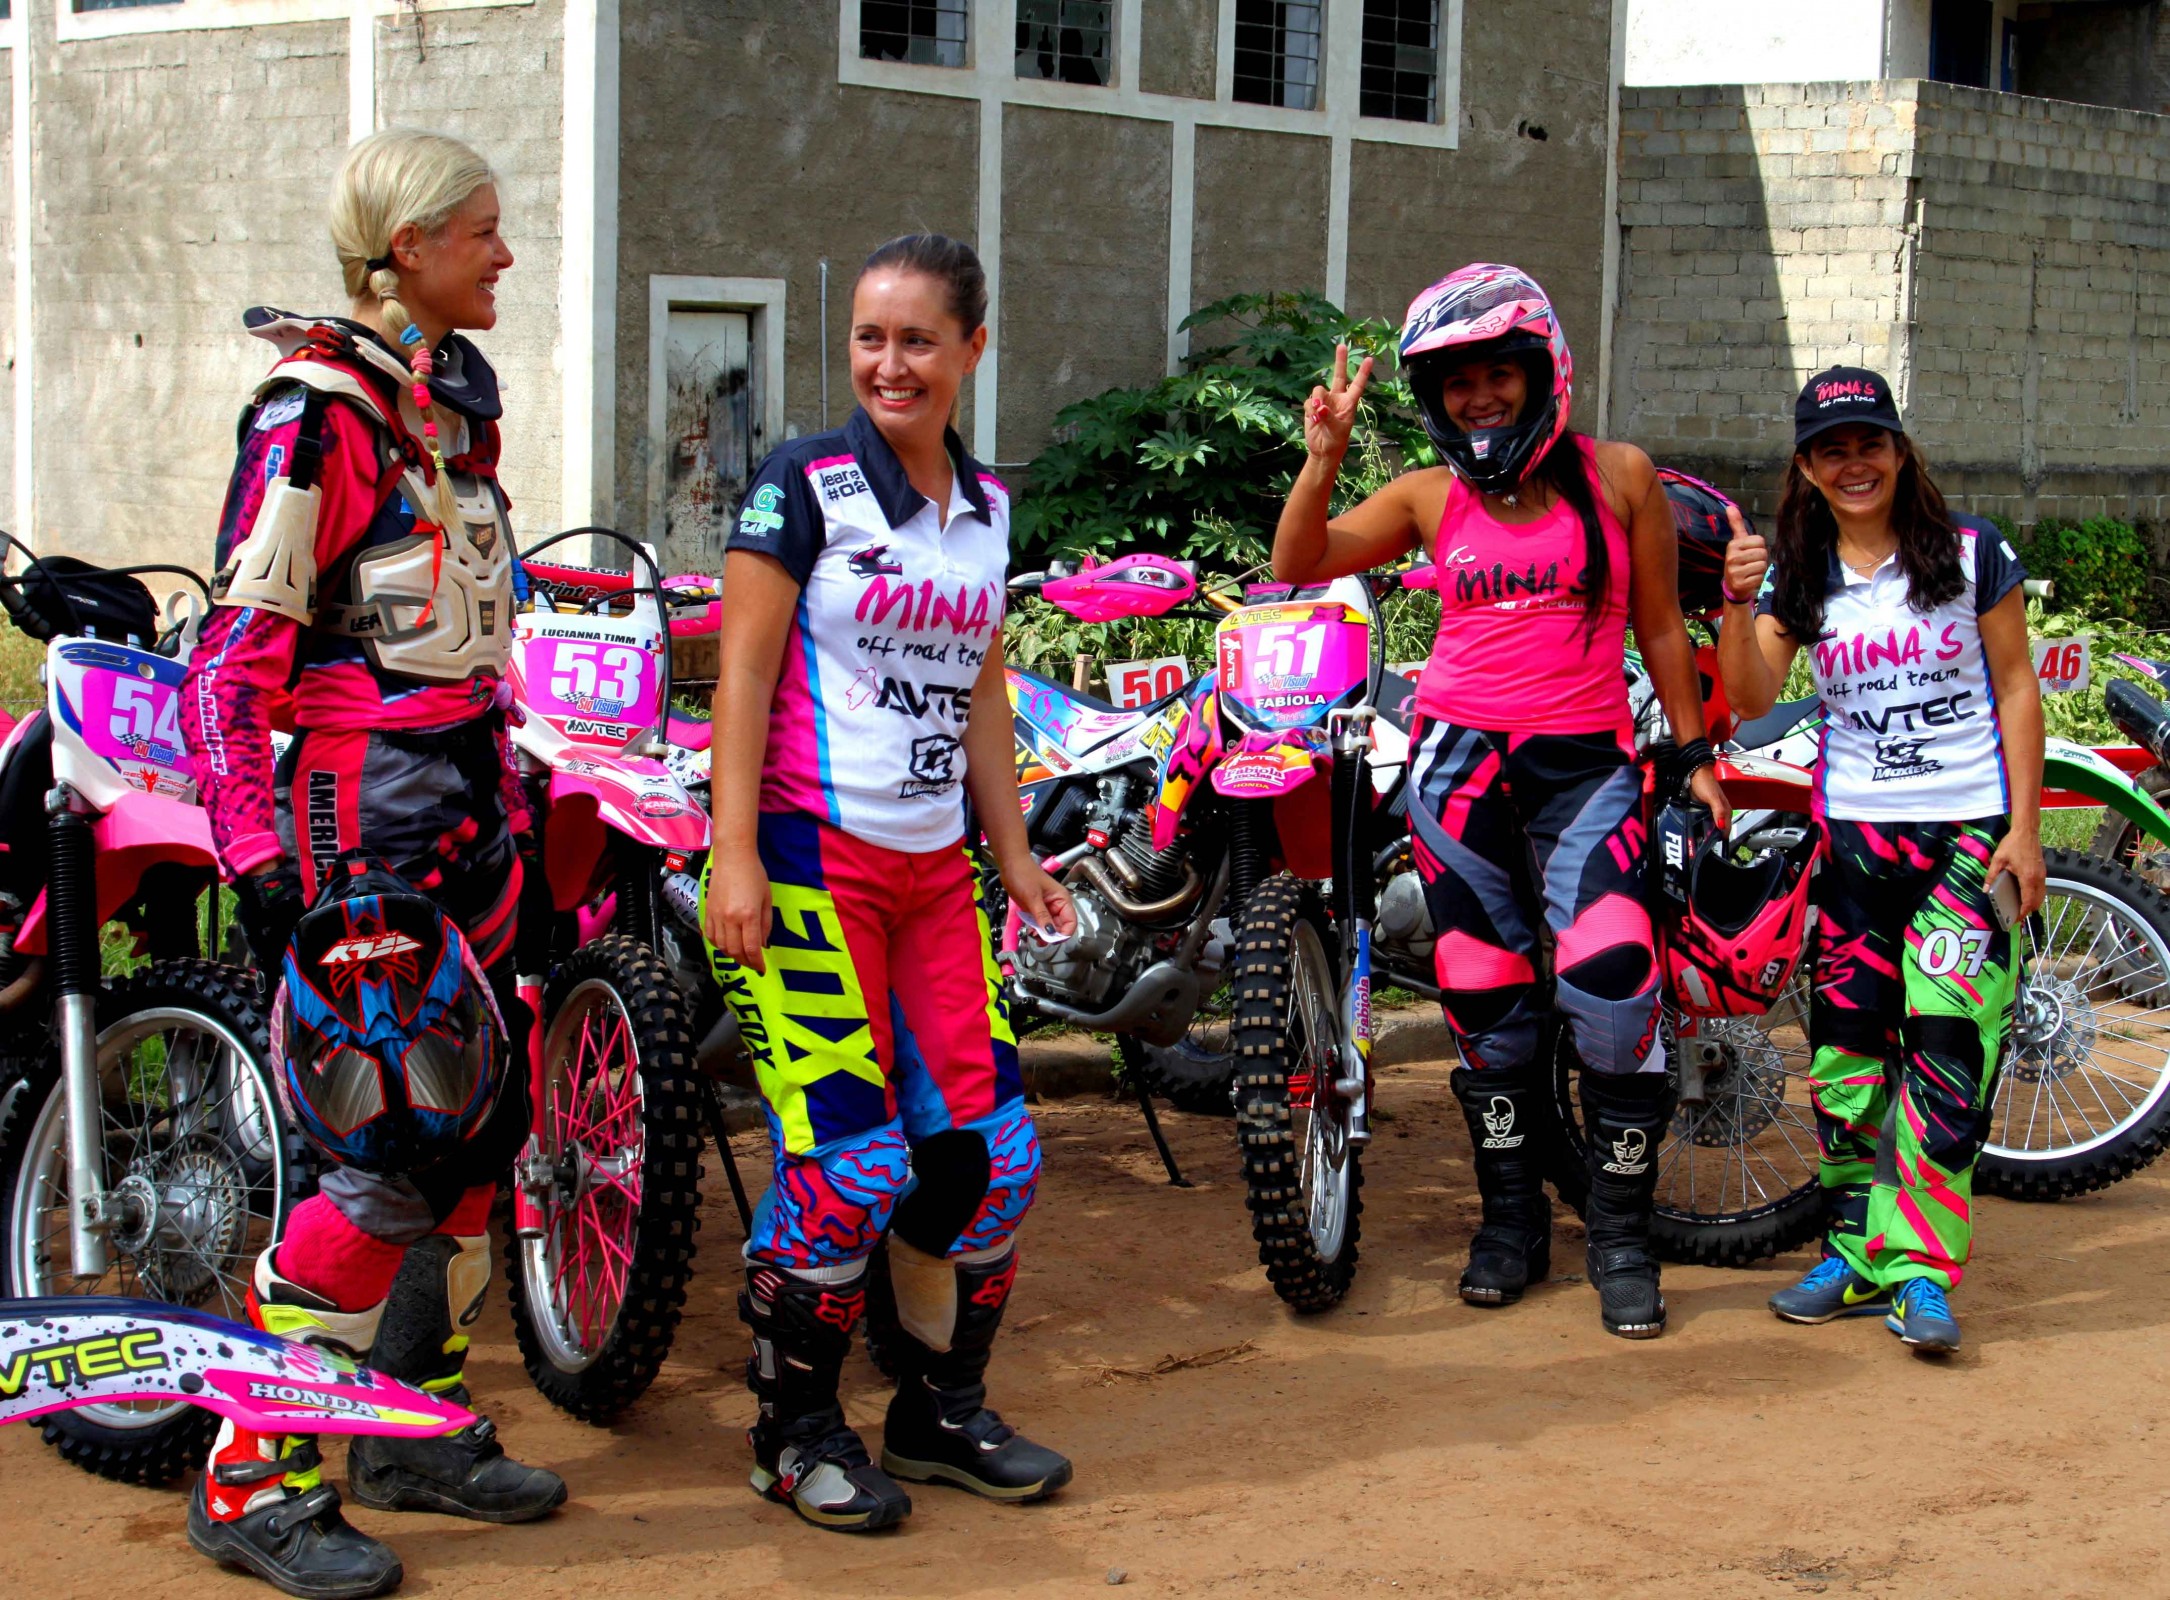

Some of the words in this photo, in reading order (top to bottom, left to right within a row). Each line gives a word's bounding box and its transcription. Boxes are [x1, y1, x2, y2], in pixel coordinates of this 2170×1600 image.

[827, 480, 870, 501] #02
[1230, 608, 1281, 625] AVTEC
[541, 627, 601, 641] LUCIANNA
[604, 633, 637, 645] TIMM
[857, 636, 896, 659] off
[903, 643, 950, 664] road
[1254, 624, 1326, 680] 51
[1816, 619, 1964, 679] MINA'S
[550, 643, 643, 709] 53
[2038, 643, 2082, 680] 46
[1123, 664, 1184, 710] 50
[1269, 674, 1311, 689] SigVisual
[1827, 683, 1852, 699] off
[1857, 675, 1898, 696] road
[1907, 668, 1960, 687] team
[110, 676, 187, 757] 54
[575, 696, 625, 716] SigVisual
[875, 677, 973, 723] AVTE
[1255, 695, 1327, 709] FABÍOLA
[1851, 690, 1977, 735] AVTEC
[133, 740, 177, 764] SigVisual
[1232, 782, 1270, 790] HONDA
[1665, 831, 1683, 871] FOX
[1918, 928, 1995, 978] 07
[1759, 961, 1780, 986] 02
[1356, 976, 1371, 1040] Fabiola
[249, 1382, 378, 1418] HONDA
